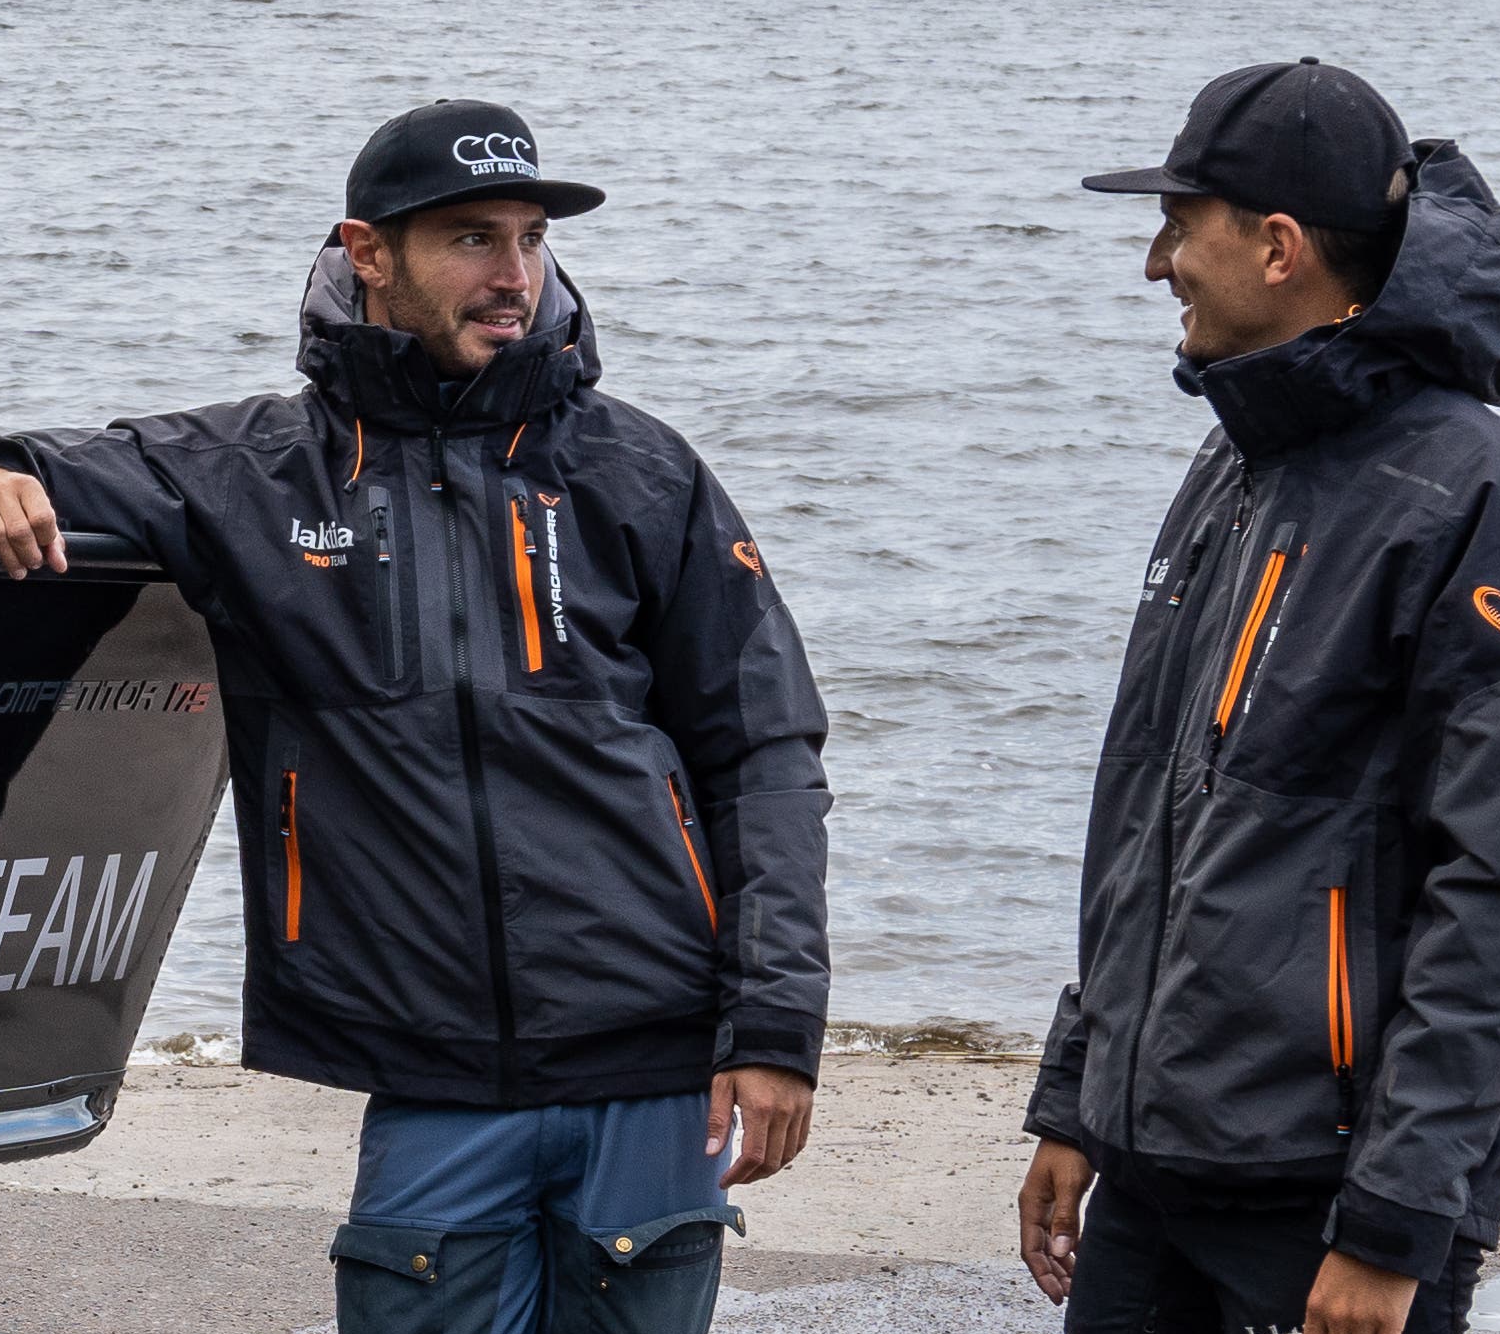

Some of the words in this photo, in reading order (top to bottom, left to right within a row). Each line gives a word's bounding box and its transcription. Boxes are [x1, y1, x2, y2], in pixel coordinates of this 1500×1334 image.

[471, 162, 495, 175] CAST
[497, 162, 515, 173] AND
[289, 518, 355, 550] Jaktia
[163, 681, 216, 714] 175
